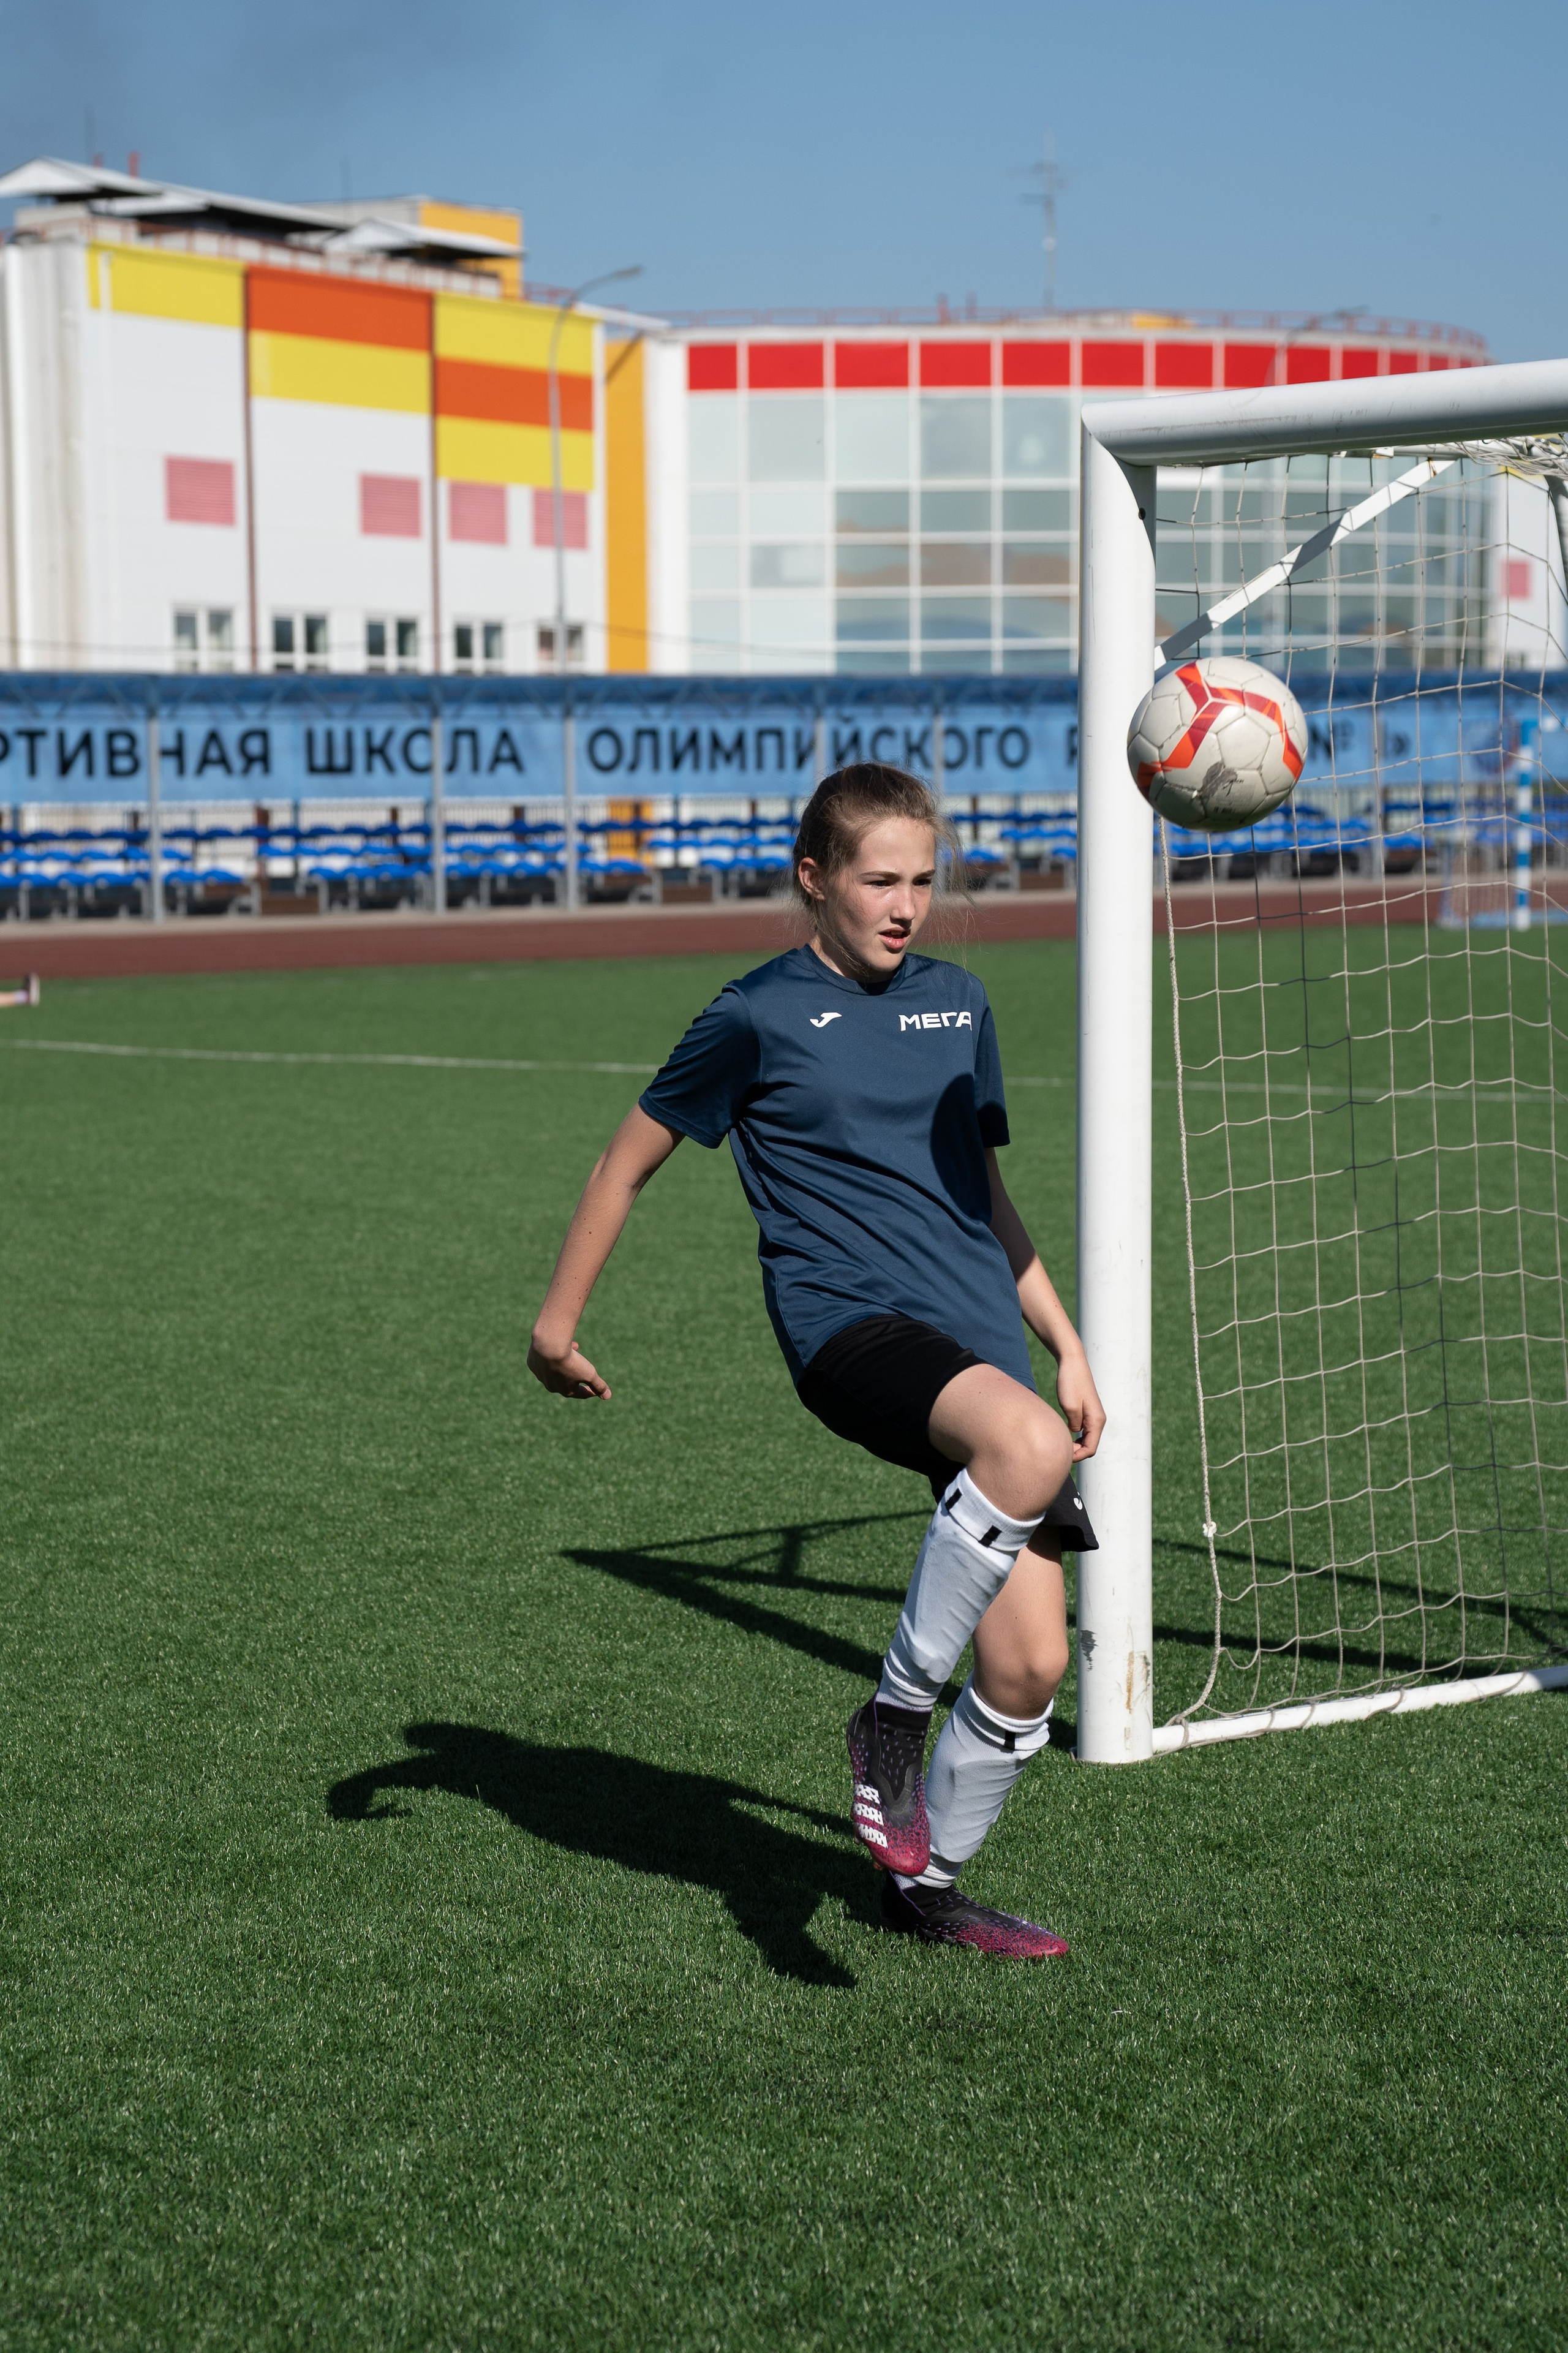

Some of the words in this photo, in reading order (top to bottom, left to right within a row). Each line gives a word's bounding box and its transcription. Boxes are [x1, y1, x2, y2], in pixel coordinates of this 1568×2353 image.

[0, 727, 272, 778] ТИВНАЯ
[305, 727, 526, 776] ШКОЛА
[586, 716, 1031, 773] ОЛИМПИЙСКОГО
[899, 1011, 972, 1032] МЕГА
